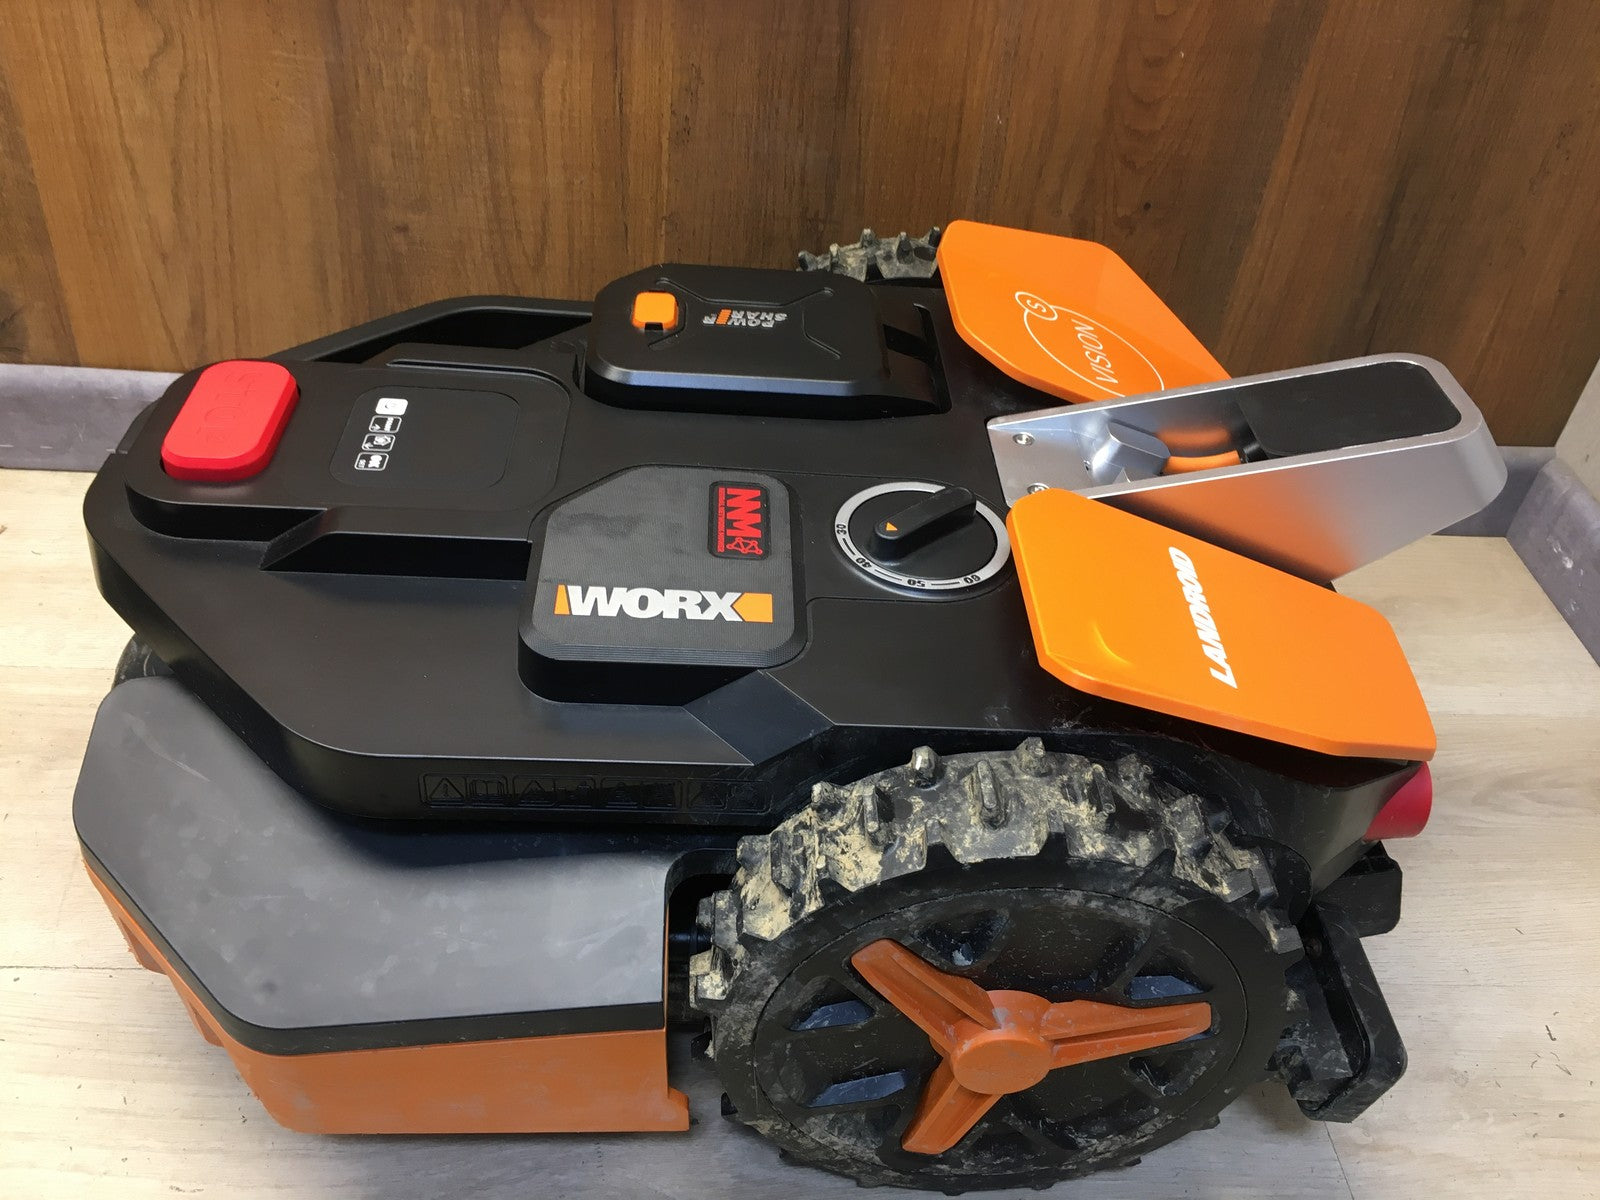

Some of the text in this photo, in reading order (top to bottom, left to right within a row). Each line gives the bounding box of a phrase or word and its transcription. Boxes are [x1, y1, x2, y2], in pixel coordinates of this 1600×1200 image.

[1071, 318, 1119, 384] VISION
[836, 523, 847, 535] 30
[907, 579, 925, 588] 50
[963, 574, 981, 584] 60
[567, 585, 744, 622] WORX
[1168, 546, 1238, 689] LANDROID
